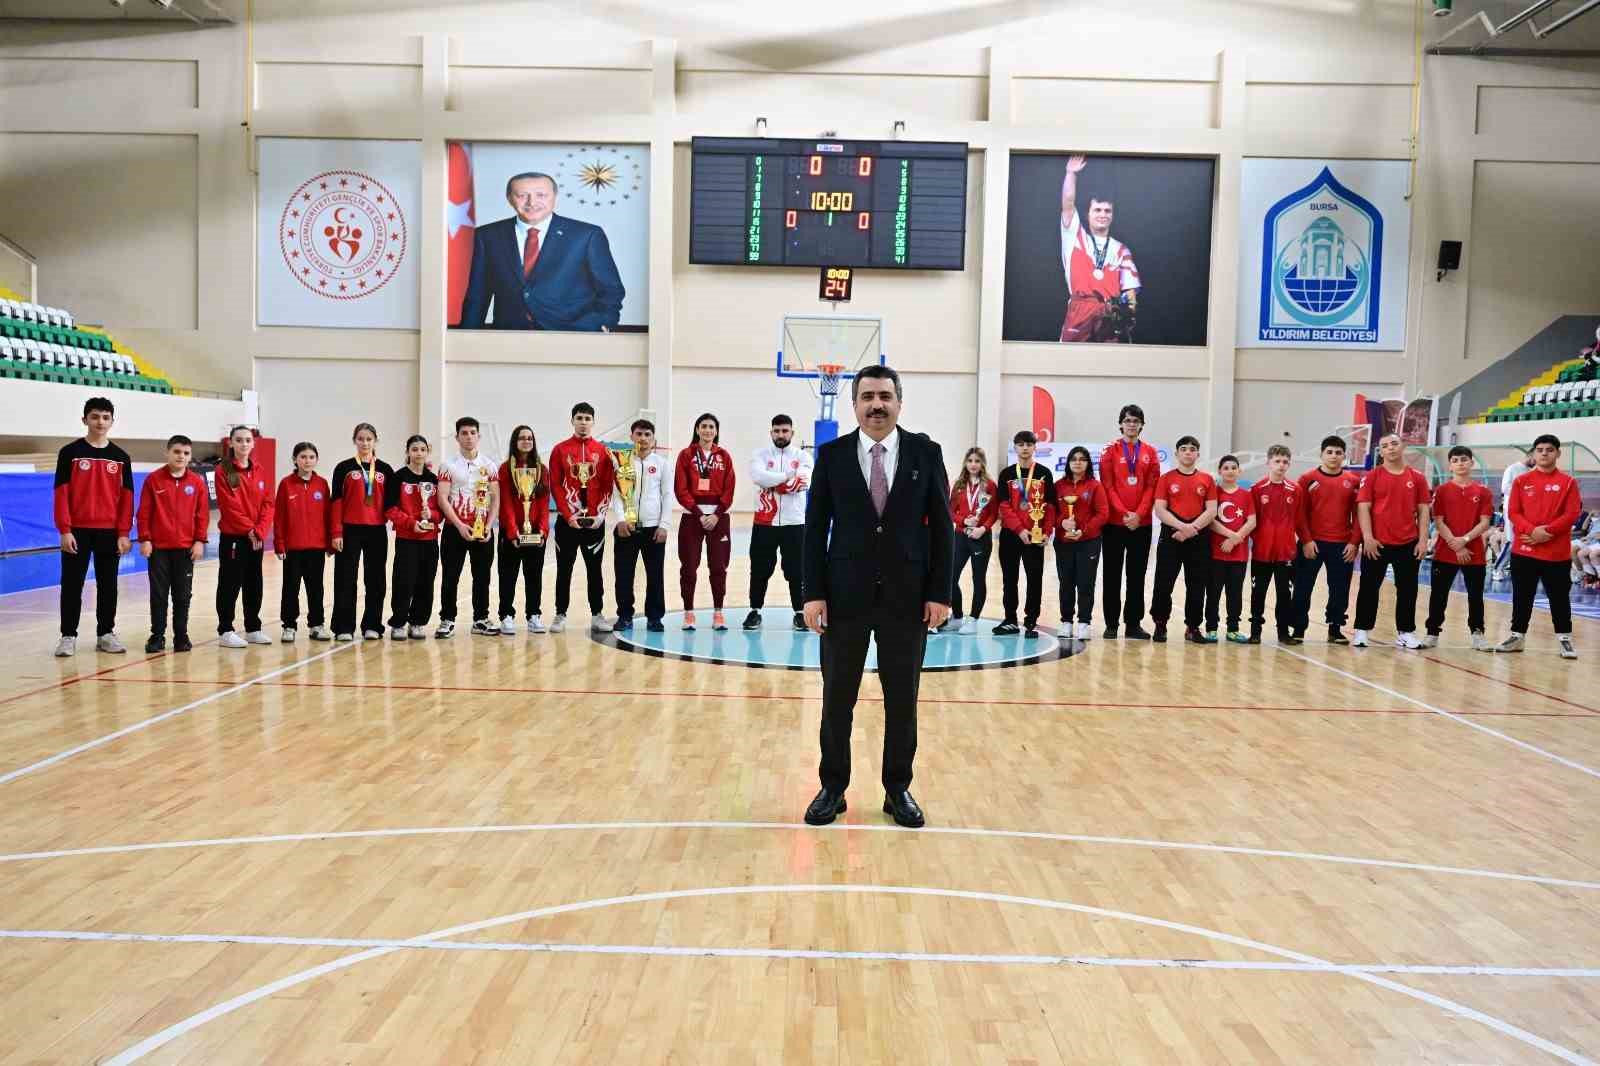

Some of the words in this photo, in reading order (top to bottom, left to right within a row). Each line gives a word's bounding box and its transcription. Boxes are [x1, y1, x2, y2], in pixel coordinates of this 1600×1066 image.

[810, 156, 822, 175] 0
[859, 157, 871, 176] 0
[811, 192, 853, 211] 10:00
[1310, 202, 1338, 211] BURSA
[786, 210, 797, 228] 0
[858, 212, 870, 230] 0
[305, 248, 333, 274] TÜRKİYE
[825, 280, 846, 297] 24
[1261, 328, 1310, 340] YILDIRIM
[1312, 329, 1376, 341] BELEDİYESİ
